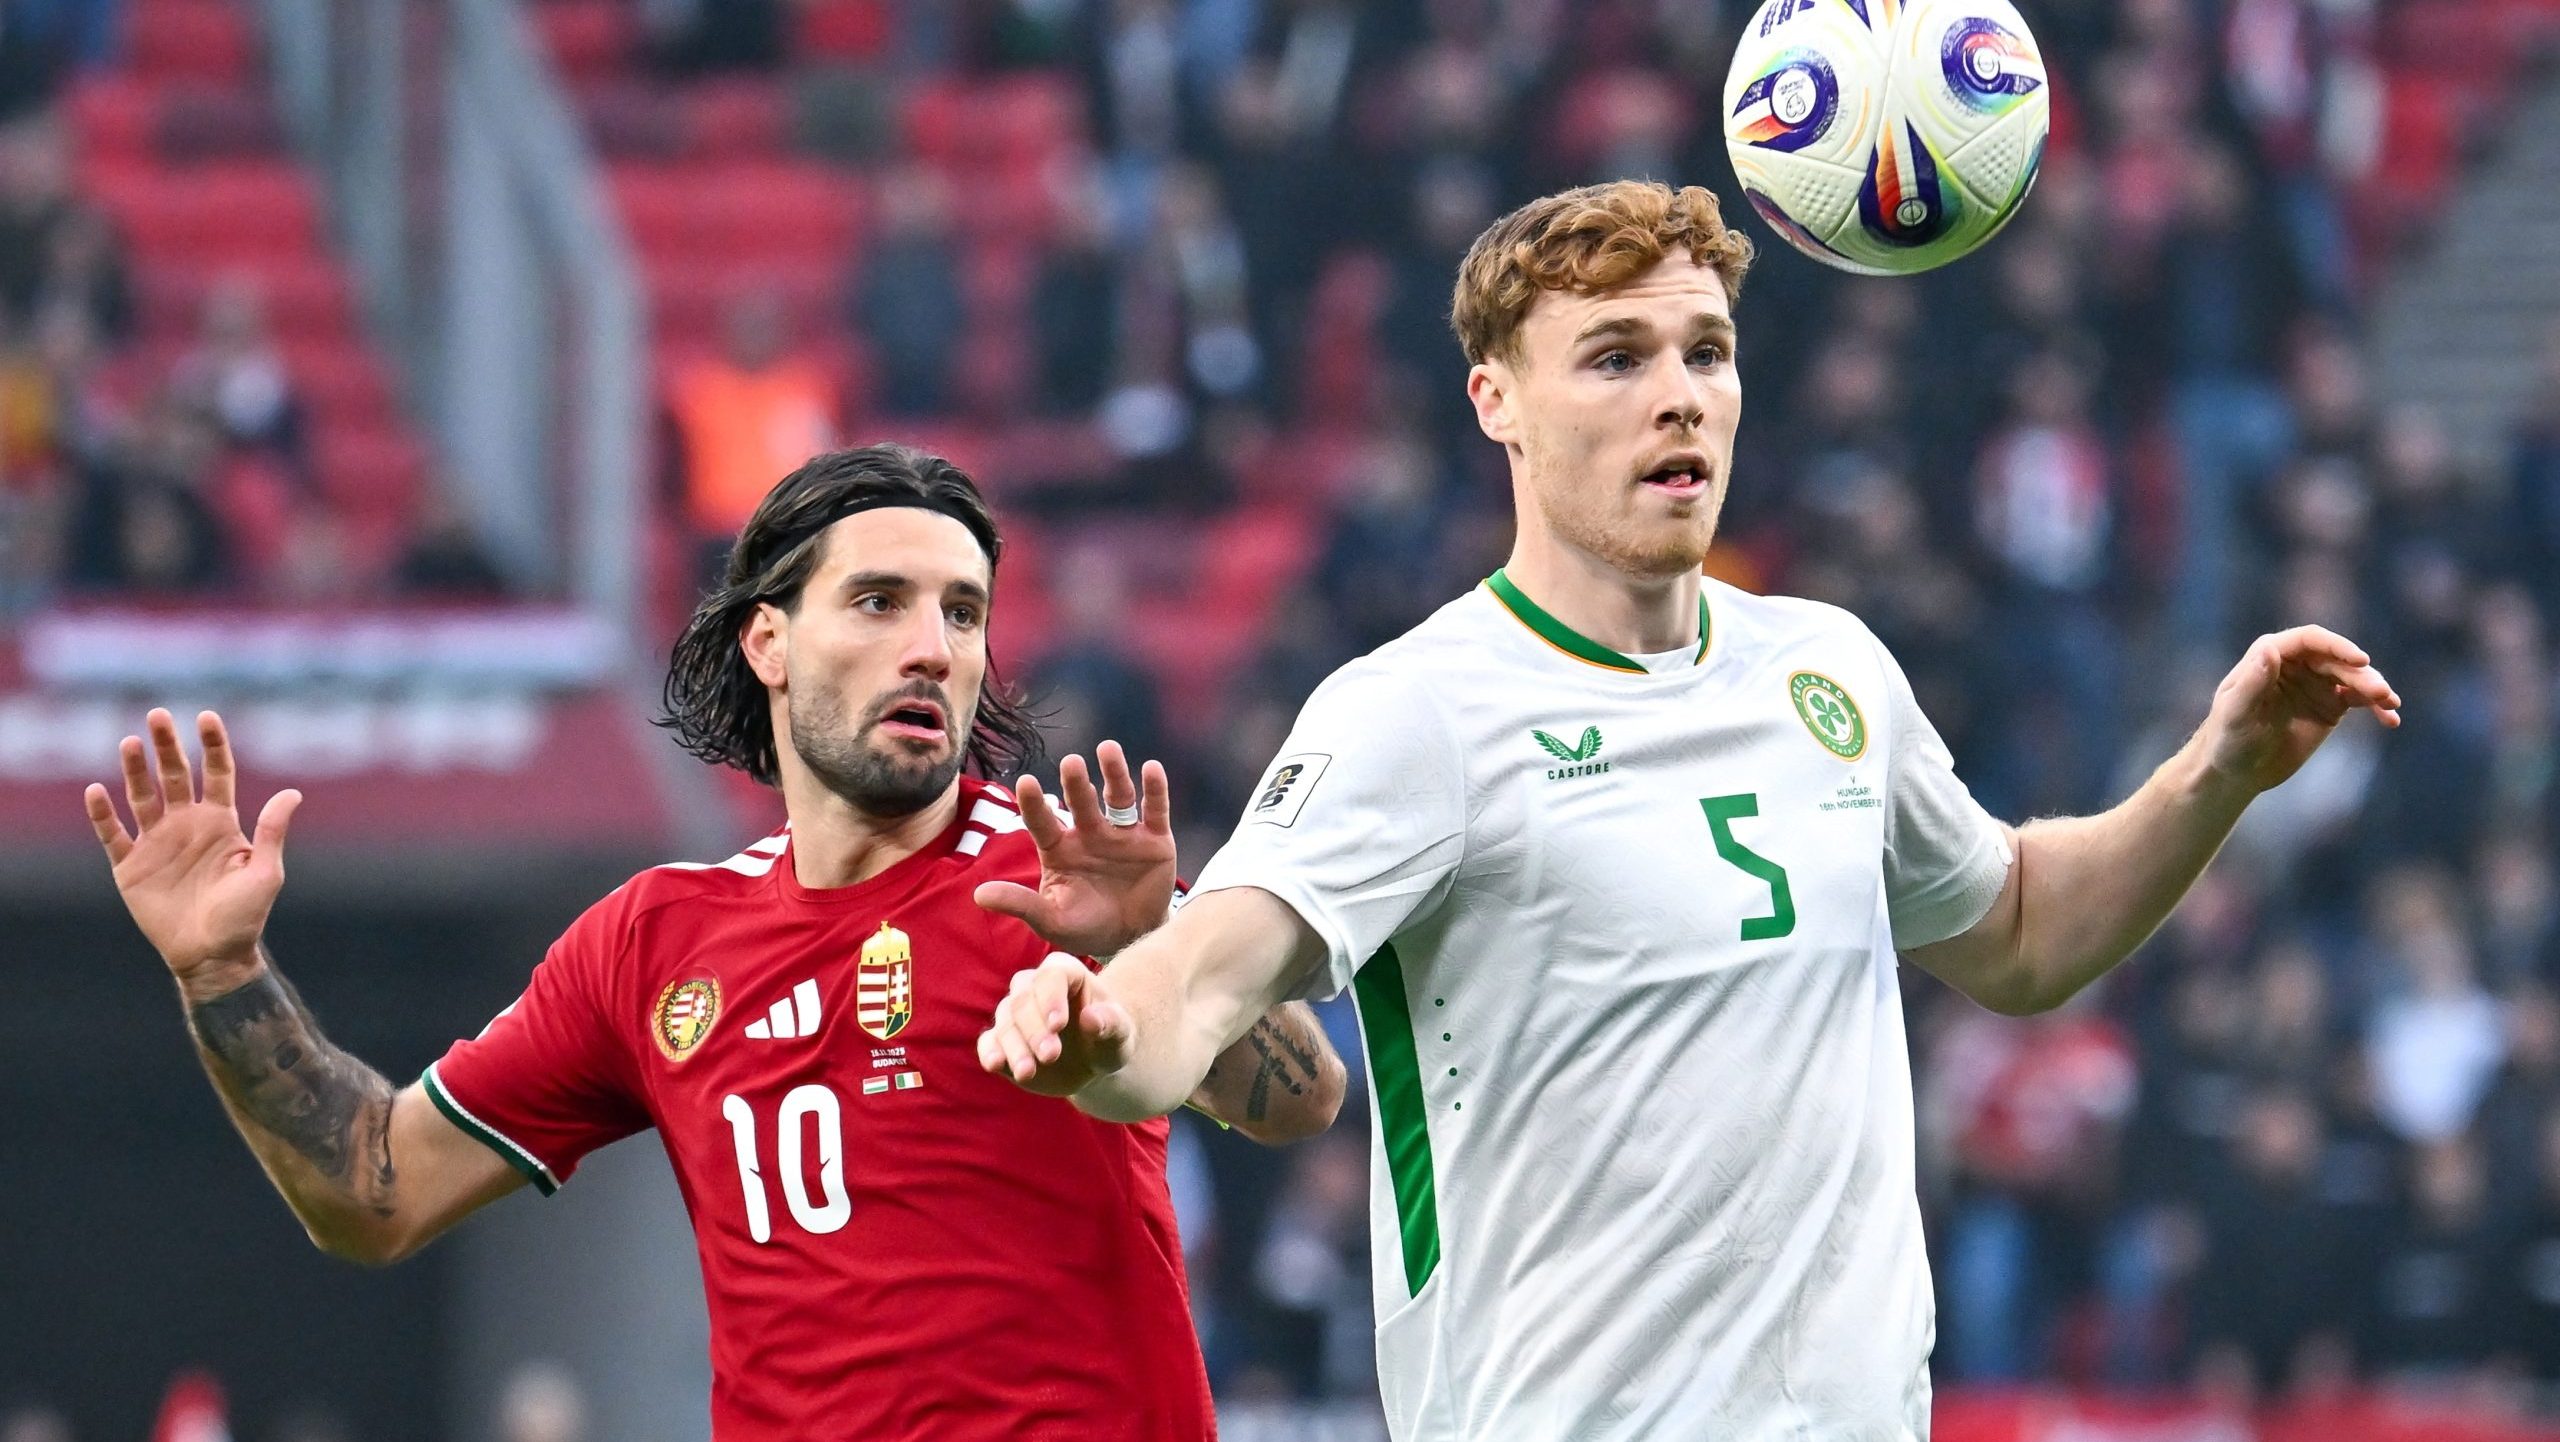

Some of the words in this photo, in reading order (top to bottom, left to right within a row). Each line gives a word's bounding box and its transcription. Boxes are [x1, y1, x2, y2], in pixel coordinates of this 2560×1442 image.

[1793, 675, 1845, 703] IRELAND
[1547, 762, 1610, 780] CASTORE
[1699, 792, 1796, 941] 5
[722, 1084, 851, 1244] 10
